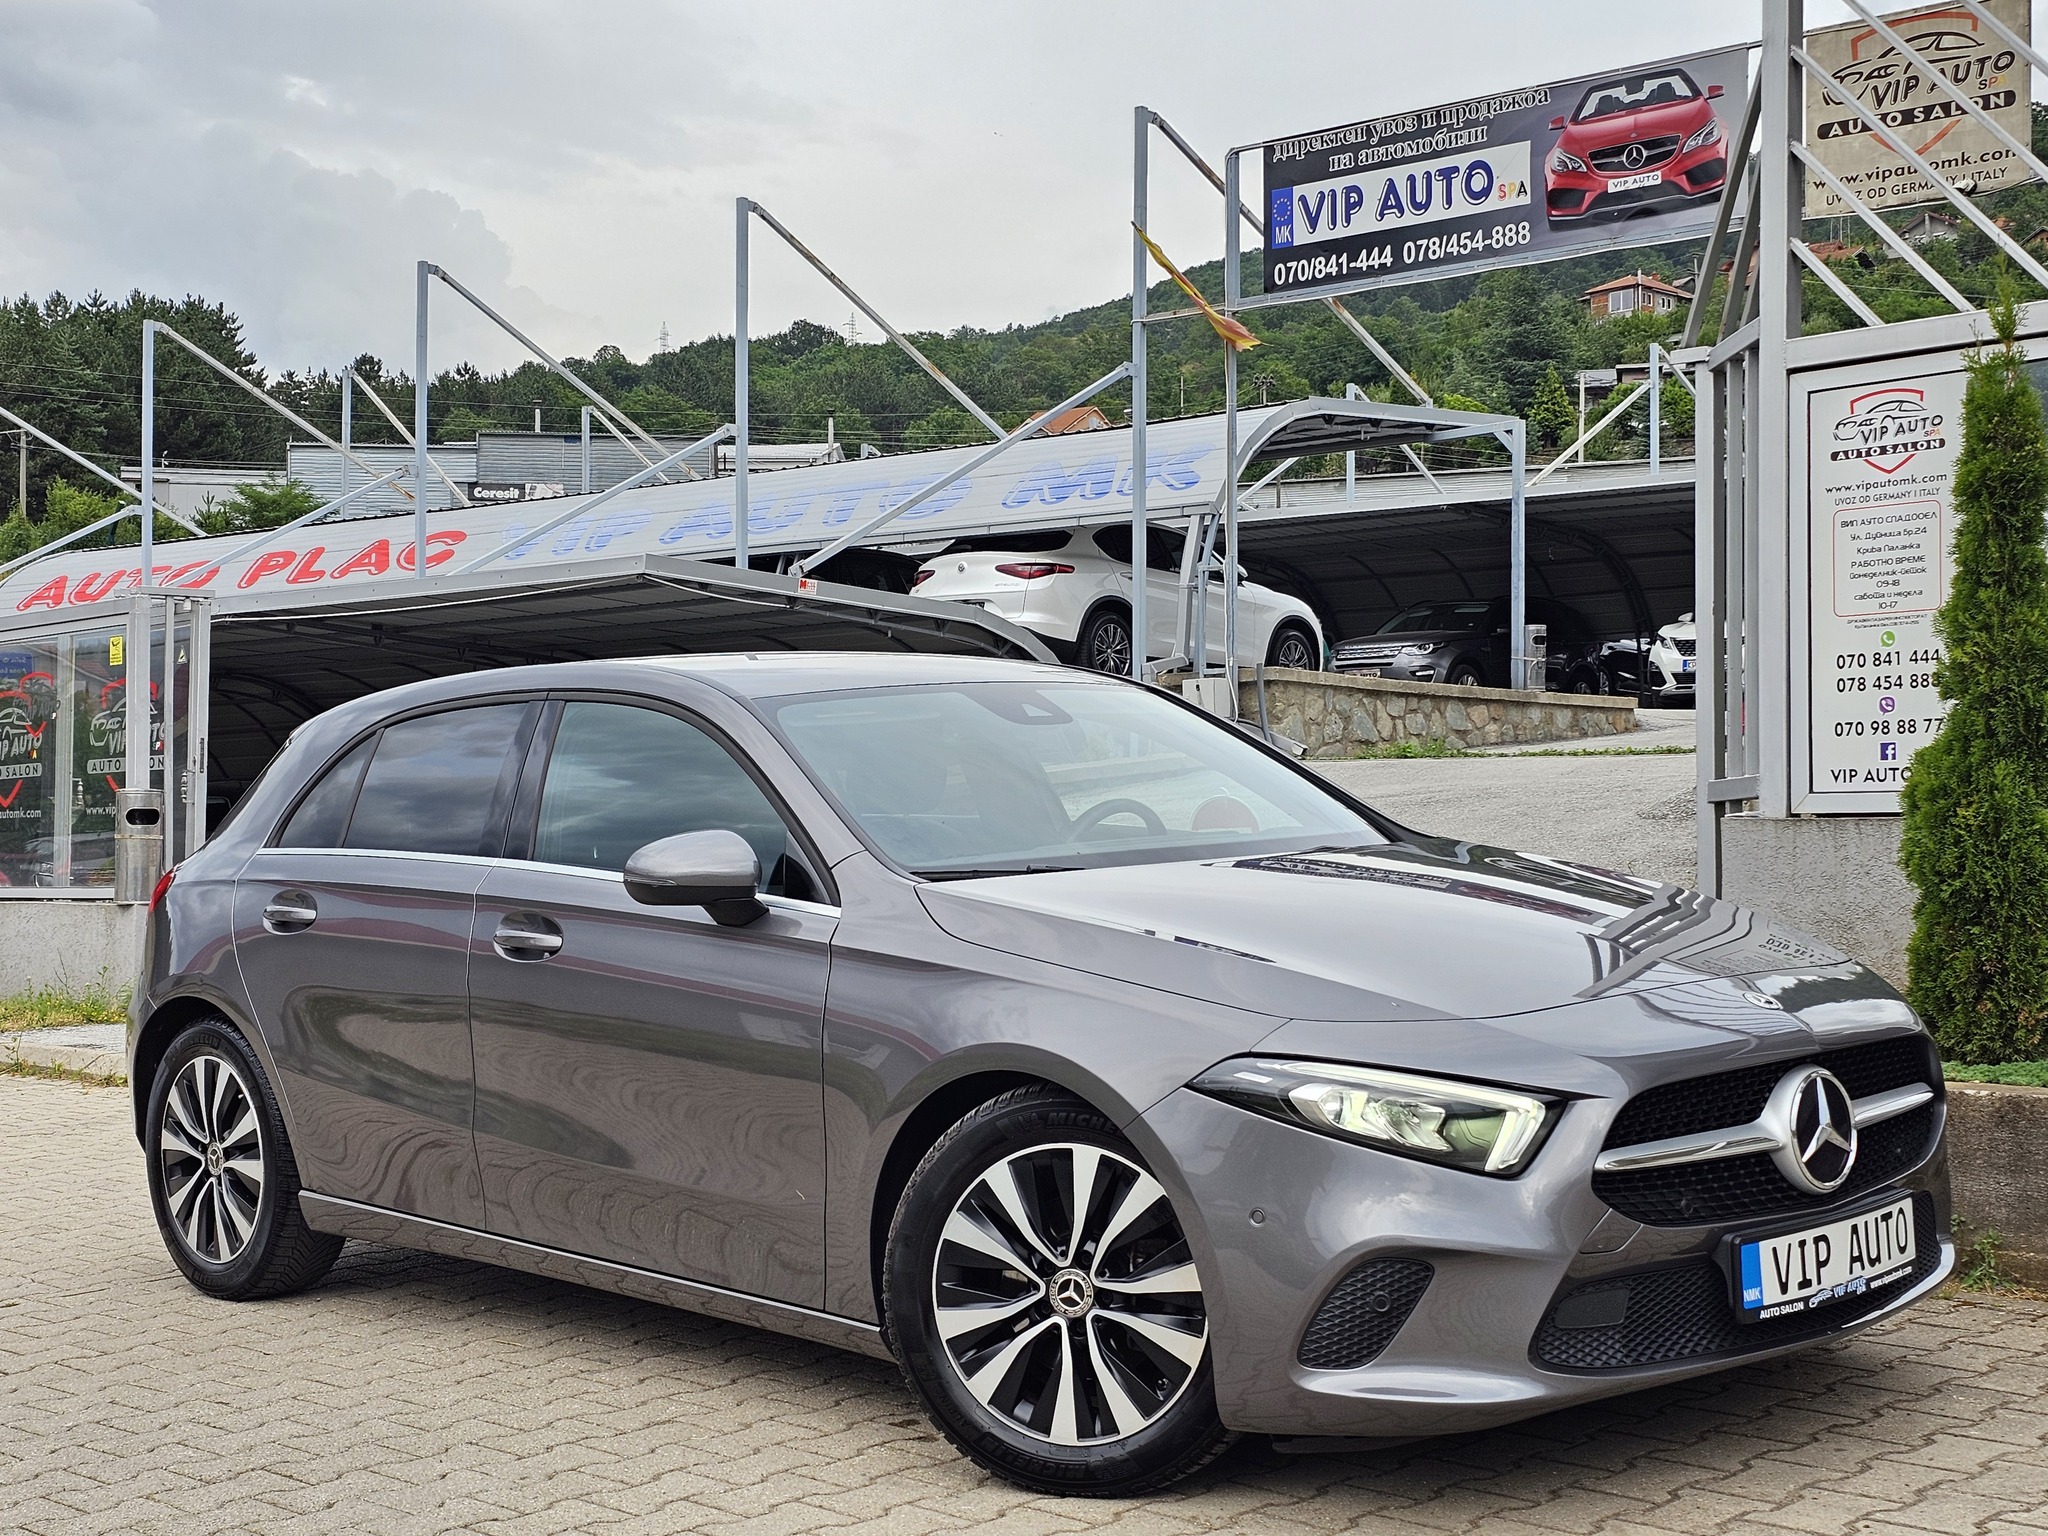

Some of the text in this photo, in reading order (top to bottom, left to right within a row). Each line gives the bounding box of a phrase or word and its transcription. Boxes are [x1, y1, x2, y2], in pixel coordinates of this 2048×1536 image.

[1978, 75, 2008, 90] SPA
[1871, 75, 1919, 110] VIP
[1273, 87, 1550, 161] директен увоз и продажба
[1828, 112, 1902, 138] AUO
[1329, 126, 1487, 172] на автомобили
[1613, 174, 1659, 188] VIP AUTO
[1298, 160, 1494, 234] VIP AUTO
[1497, 180, 1528, 202] SPA
[1867, 187, 1886, 199] OD
[1275, 225, 1292, 245] MK
[1274, 221, 1531, 286] 070/841-444 078/454-888
[1860, 415, 1943, 445] VIP AUTO
[1923, 428, 1941, 437] SPA
[1837, 440, 1940, 460] AUTO SALON
[1825, 473, 1947, 494] www.vipautomk.com
[473, 487, 520, 499] Ceresit
[1834, 496, 1856, 506] UVOZ
[1859, 494, 1871, 503] OD
[1873, 491, 1911, 502] GERMANY
[1919, 487, 1940, 497] ITALY
[502, 444, 1216, 561] VIP AUTO MK
[1840, 520, 1858, 529] ВИП
[1860, 517, 1884, 527] АУТО
[237, 529, 467, 590] PLAC
[1851, 555, 1926, 569] РАБОТНО ВРЕМЕ
[1876, 579, 1900, 589] 09-18
[1893, 590, 1923, 599] недела
[1878, 601, 1898, 610] 10-17
[1836, 649, 1940, 669] 070 841 444
[1837, 676, 1866, 693] 078
[1872, 675, 1903, 690] 454
[1834, 721, 1865, 737] 070
[1870, 720, 1890, 735] 98
[1897, 719, 1917, 735] 88
[11, 733, 42, 757] AUTO
[6, 765, 39, 777] SALON
[92, 759, 121, 772] AUTO
[1830, 769, 1858, 783] VIP
[1772, 1206, 1908, 1295] VIP AUTO
[1743, 1287, 1761, 1303] NMK
[1759, 1307, 1780, 1319] AUTO
[1780, 1301, 1804, 1315] SALON
